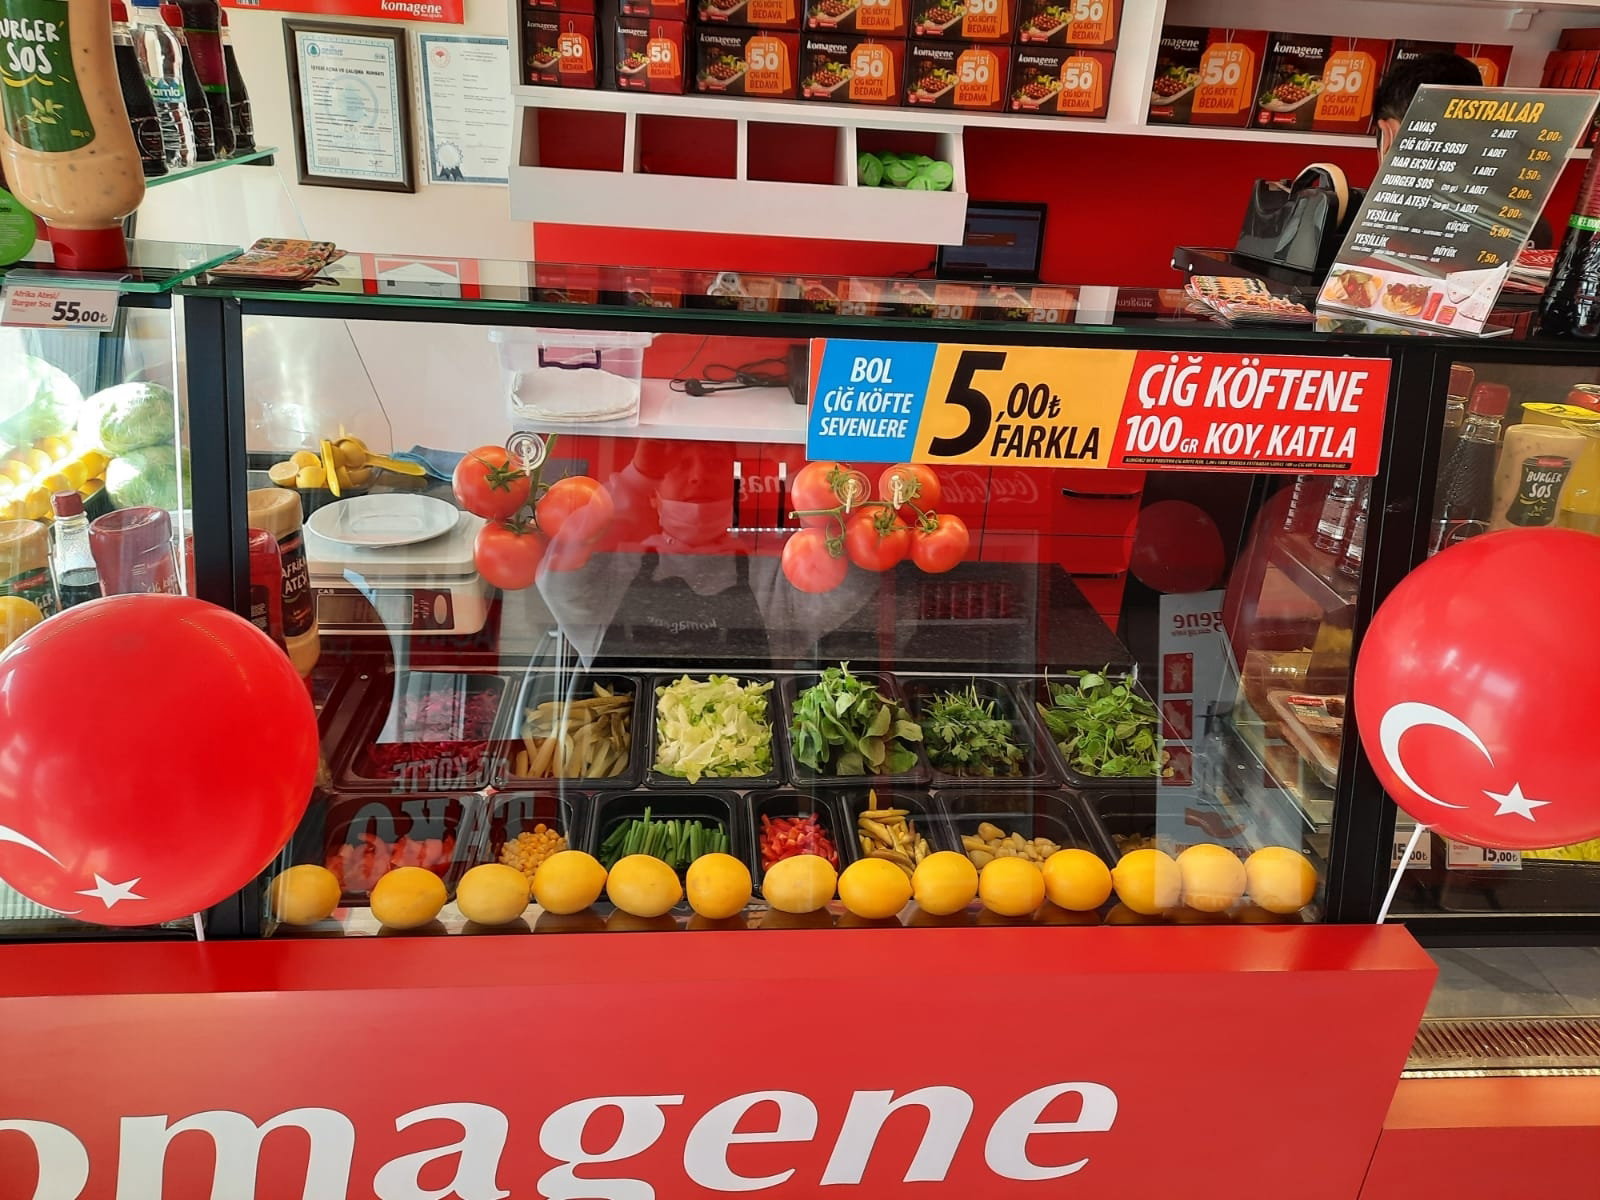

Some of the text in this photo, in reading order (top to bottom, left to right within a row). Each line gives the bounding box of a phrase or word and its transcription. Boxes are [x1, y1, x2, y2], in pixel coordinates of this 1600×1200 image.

[381, 0, 442, 15] komagene
[861, 16, 891, 26] BEDAVA
[967, 24, 996, 34] BEDAVA
[0, 18, 60, 42] URGER
[1071, 30, 1101, 40] BEDAVA
[700, 33, 742, 45] komagene
[806, 40, 848, 53] komagene
[1161, 38, 1200, 49] magene
[562, 41, 583, 57] 50
[651, 47, 671, 62] 50
[913, 46, 954, 59] komagene
[1273, 41, 1324, 57] komagene
[6, 42, 52, 75] SOS
[750, 48, 779, 70] 50
[855, 55, 884, 77] 50
[1018, 53, 1059, 65] komagene
[961, 62, 989, 83] 50
[1064, 68, 1093, 90] 50
[1204, 58, 1241, 85] 50
[1326, 66, 1362, 93] 50
[152, 86, 181, 97] amla
[750, 79, 779, 89] BEDAVA
[854, 87, 883, 96] BEDAVA
[959, 91, 988, 102] BEDAVA
[1062, 98, 1090, 108] BEDAVA
[1198, 97, 1235, 109] BEDAVA
[1321, 105, 1355, 116] BEDAVA
[1443, 98, 1545, 123] EKSTRALAR
[1407, 120, 1437, 135] LAVAŞ
[1490, 129, 1497, 138] 2
[1497, 129, 1518, 140] ADET
[1399, 138, 1413, 151] ÇİĞ
[1414, 140, 1444, 154] KÖFTE
[1444, 142, 1468, 155] SOSU
[1481, 148, 1487, 156] 1
[1487, 148, 1508, 158] ADET
[1390, 157, 1411, 167] NAR
[1411, 157, 1437, 171] EKŞİLİ
[1437, 161, 1456, 172] SOS
[1472, 166, 1478, 175] 1
[1477, 167, 1498, 177] ADET
[1381, 174, 1415, 188] BURGER
[1415, 178, 1434, 190] SOS
[1463, 184, 1469, 193] 1
[1468, 185, 1489, 195] ADET
[1373, 190, 1404, 204] AFRİKA
[1404, 194, 1432, 209] ATEŞİ
[1460, 204, 1480, 214] ADET
[1366, 208, 1402, 223] YEŞİLLİK
[1445, 221, 1471, 233] KÜÇÜK
[1354, 232, 1390, 248] YEŞİLLİK
[1433, 246, 1458, 258] BÜYÜK
[850, 357, 893, 384] BOL
[1138, 354, 1369, 413] ÇİĞ KÖFTENE
[823, 386, 914, 414] ÇİĞ KÖFTE
[818, 417, 909, 439] SEVENLERE
[990, 424, 1100, 460] FARKLA
[1203, 422, 1263, 459] KOY,
[1265, 425, 1357, 459] KATLA
[1526, 471, 1562, 483] BURGER
[1529, 483, 1553, 498] SOS
[0, 1080, 1118, 1200] omagene
